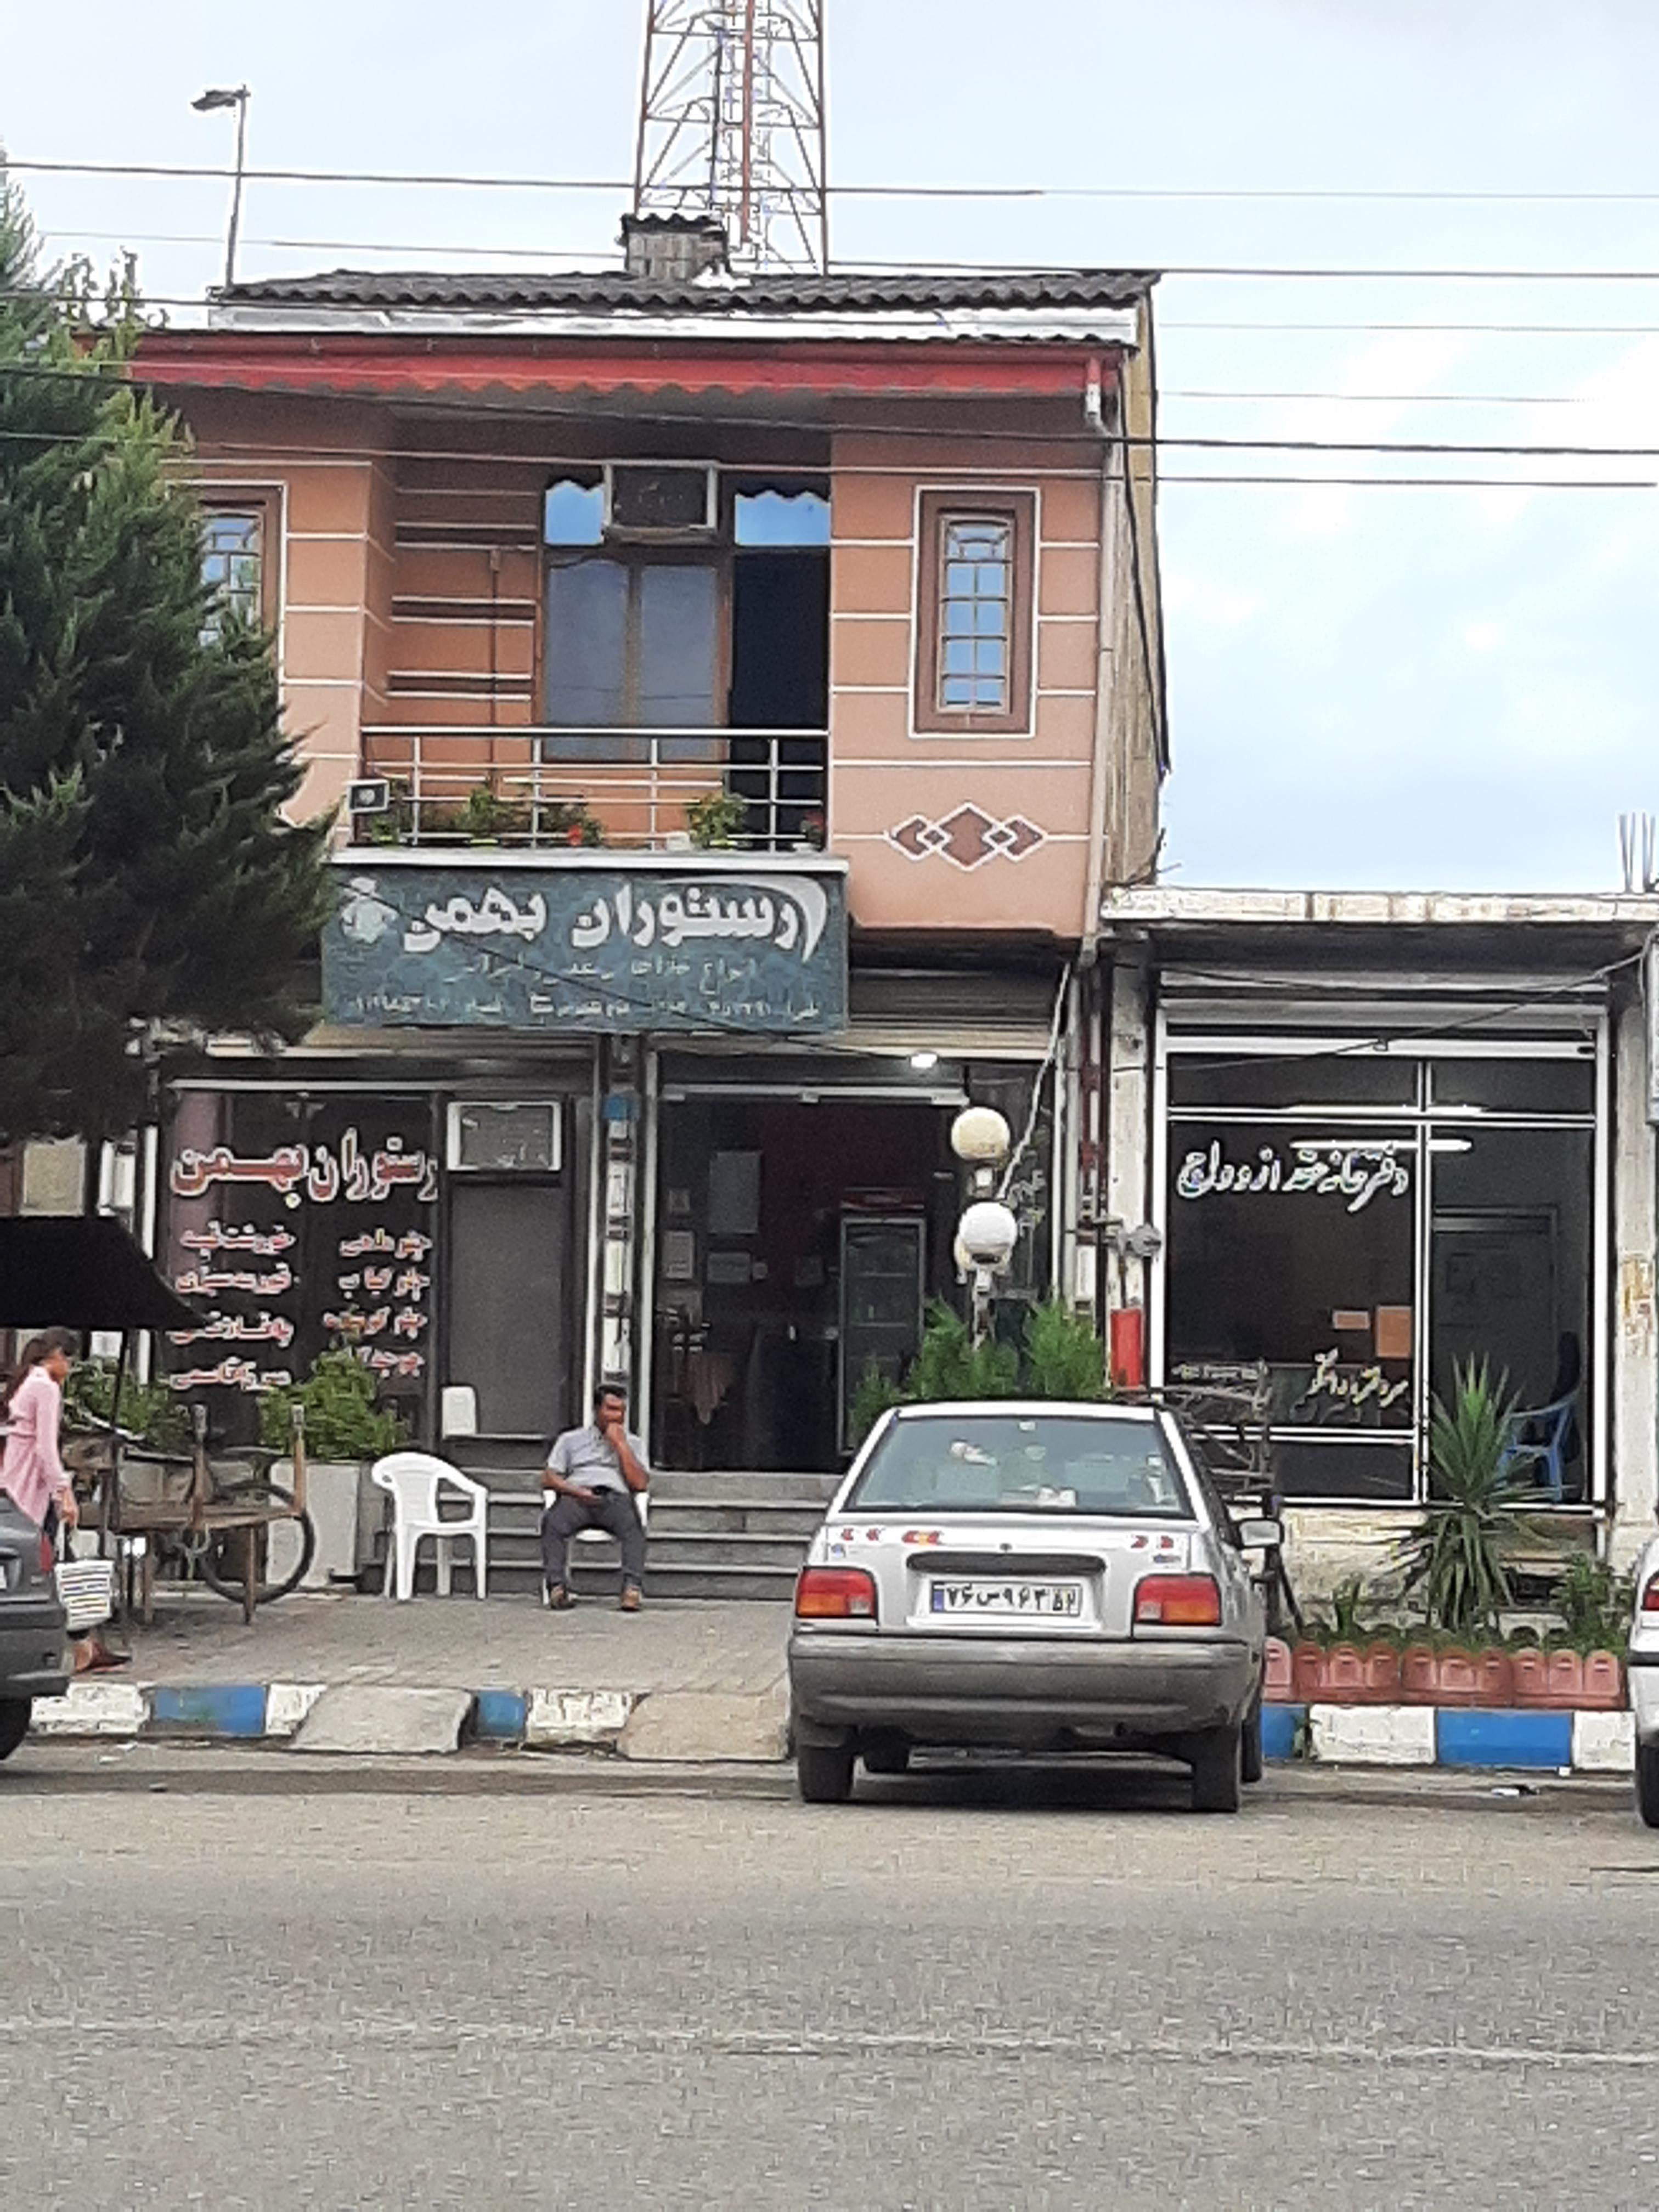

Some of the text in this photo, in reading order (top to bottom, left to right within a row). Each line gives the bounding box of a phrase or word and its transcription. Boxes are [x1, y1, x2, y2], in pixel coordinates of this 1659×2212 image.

[403, 881, 800, 952] رستوران بهمن
[170, 1127, 438, 1208] رستوران بهمن
[1177, 1139, 1282, 1198] ازدواج
